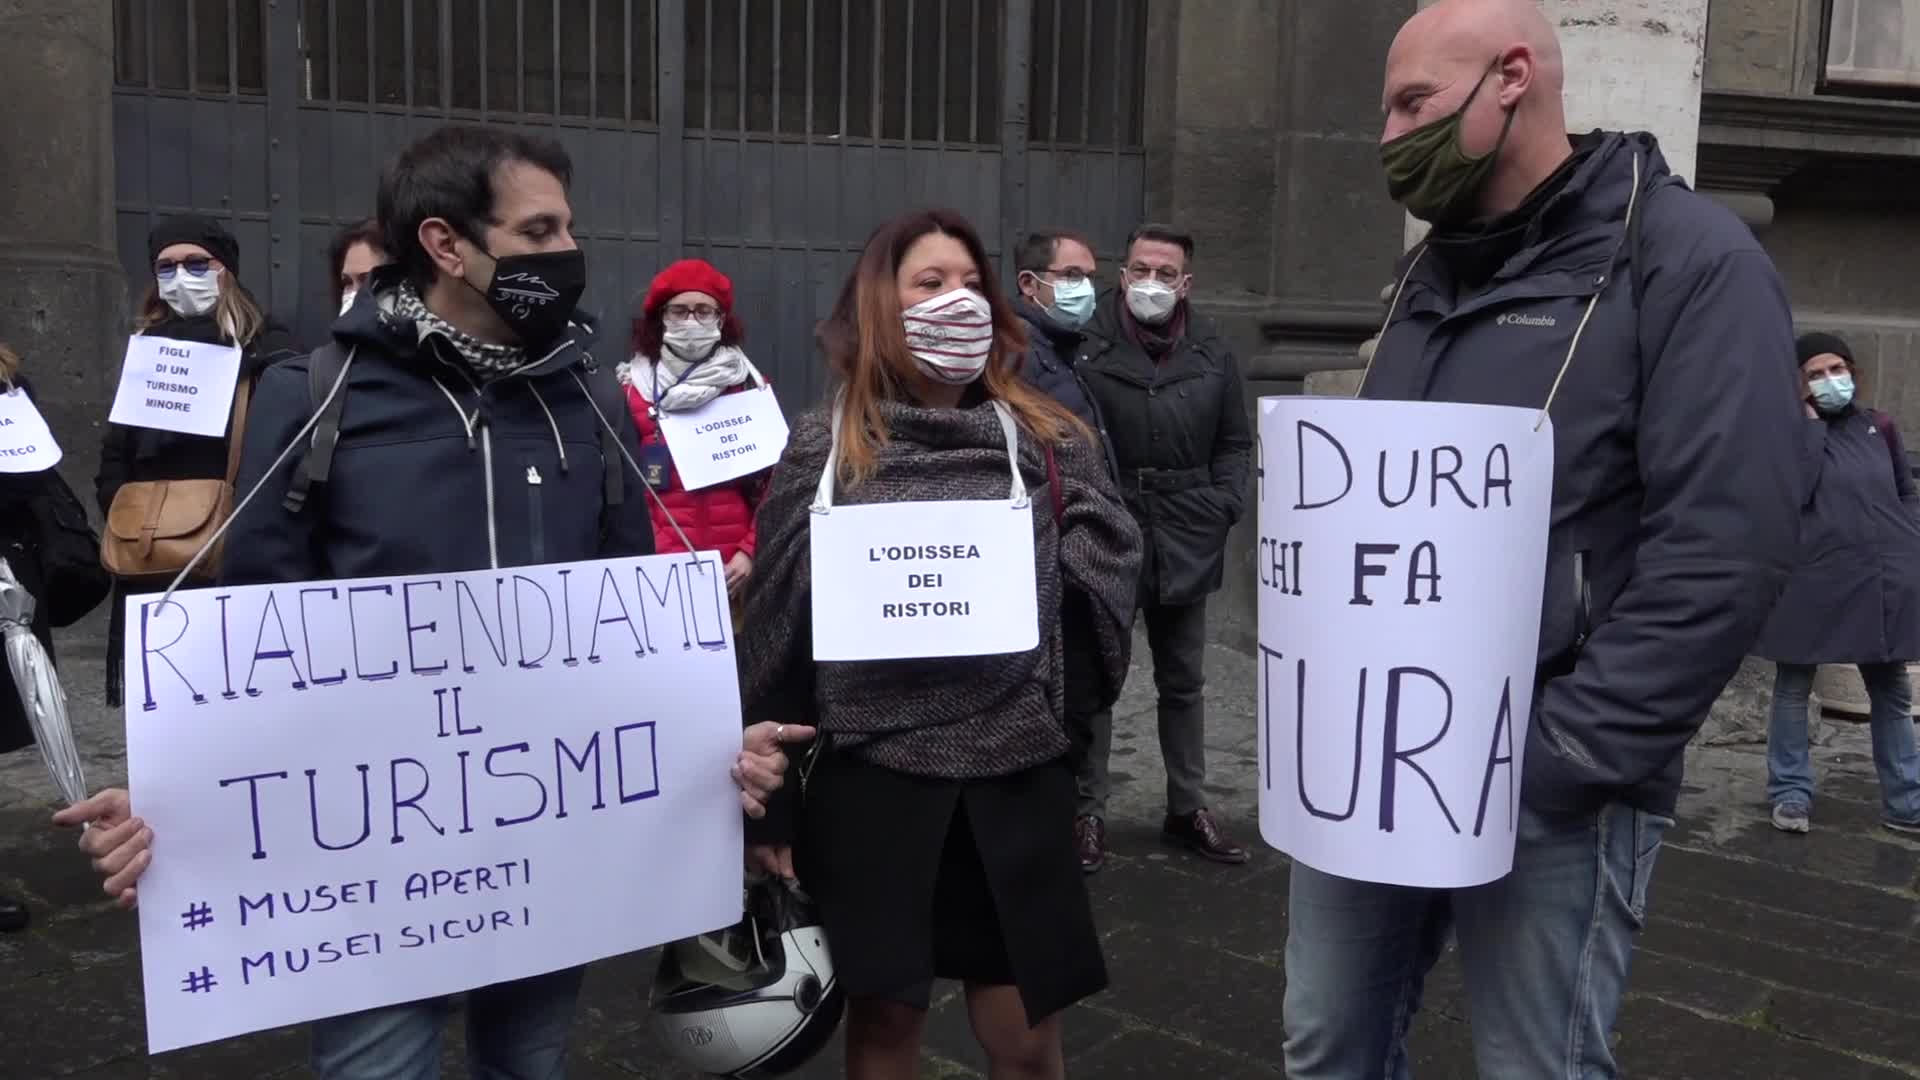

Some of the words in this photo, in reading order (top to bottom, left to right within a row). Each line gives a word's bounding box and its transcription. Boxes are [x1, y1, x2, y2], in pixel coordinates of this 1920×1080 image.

[1507, 313, 1556, 326] Columbia
[159, 346, 190, 358] FIGLI
[155, 364, 167, 373] DI
[170, 365, 189, 376] UN
[146, 380, 198, 395] TURISMO
[145, 398, 191, 412] MINORE
[695, 415, 752, 434] L'ODISSEA
[720, 433, 738, 444] DEI
[711, 443, 757, 461] RISTORI
[1293, 419, 1512, 510] DURA
[869, 544, 981, 562] L'ODISSEA
[1260, 536, 1302, 596] CHI
[1349, 540, 1441, 606] FA
[908, 573, 943, 589] DEI
[883, 601, 970, 618] RISTORI
[141, 560, 728, 711] RIACCENDIAMO
[433, 687, 482, 737] IL
[219, 721, 660, 860] TURISMO
[404, 859, 531, 901] APERTI
[241, 933, 382, 985] MUSEI
[399, 906, 530, 948] SICURI
